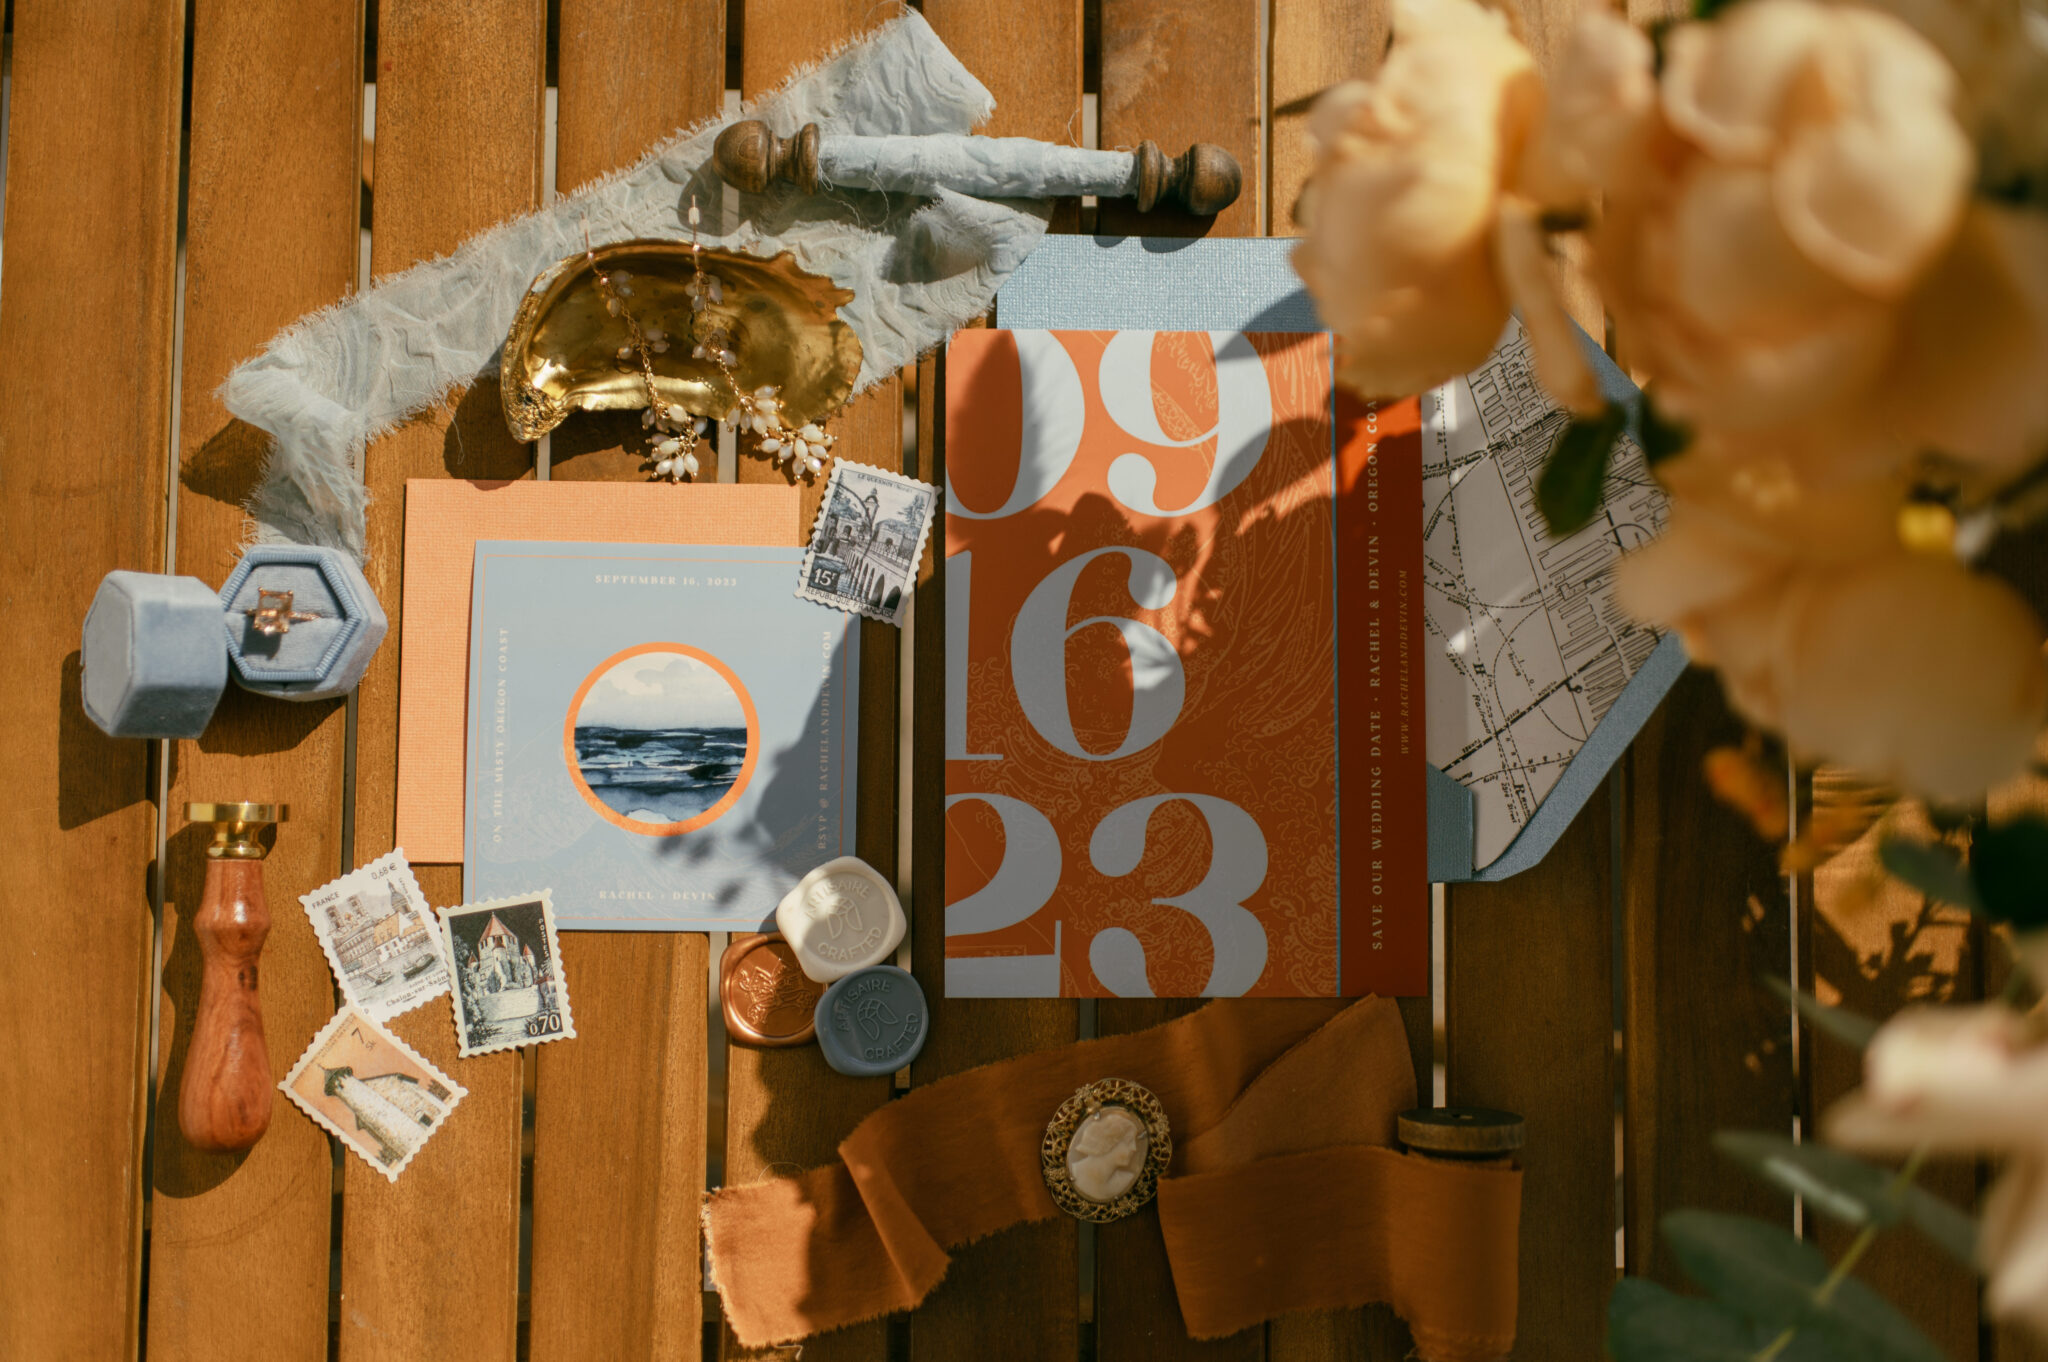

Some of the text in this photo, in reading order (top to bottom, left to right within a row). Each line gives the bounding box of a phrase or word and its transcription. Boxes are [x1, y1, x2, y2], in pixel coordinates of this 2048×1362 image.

[945, 330, 1272, 519] 09
[593, 574, 737, 588] SEPTEMBER 16, 2023
[945, 545, 1185, 762] 16
[1367, 399, 1383, 951] SAVE OUR WEDDING DATE RACHEL & DEVIN OREGON COA
[1398, 569, 1410, 755] WWW.RACHELANDDEVIN.COM
[493, 626, 509, 844] ON THE MISTY OREGON COAST
[818, 631, 832, 791] RACHELANDDEVIN.COM
[1471, 693, 1493, 734] Railroad
[817, 814, 828, 849] RSVP
[311, 891, 340, 910] FRANCE
[599, 890, 716, 902] RACHEL DEVIN
[945, 792, 1269, 998] 23
[817, 926, 884, 962] CRAFTED
[528, 1013, 562, 1037] 0,70
[834, 978, 892, 1033] ARTISAIRE
[351, 1027, 368, 1045] 7
[863, 1012, 921, 1060] CRAFTED
